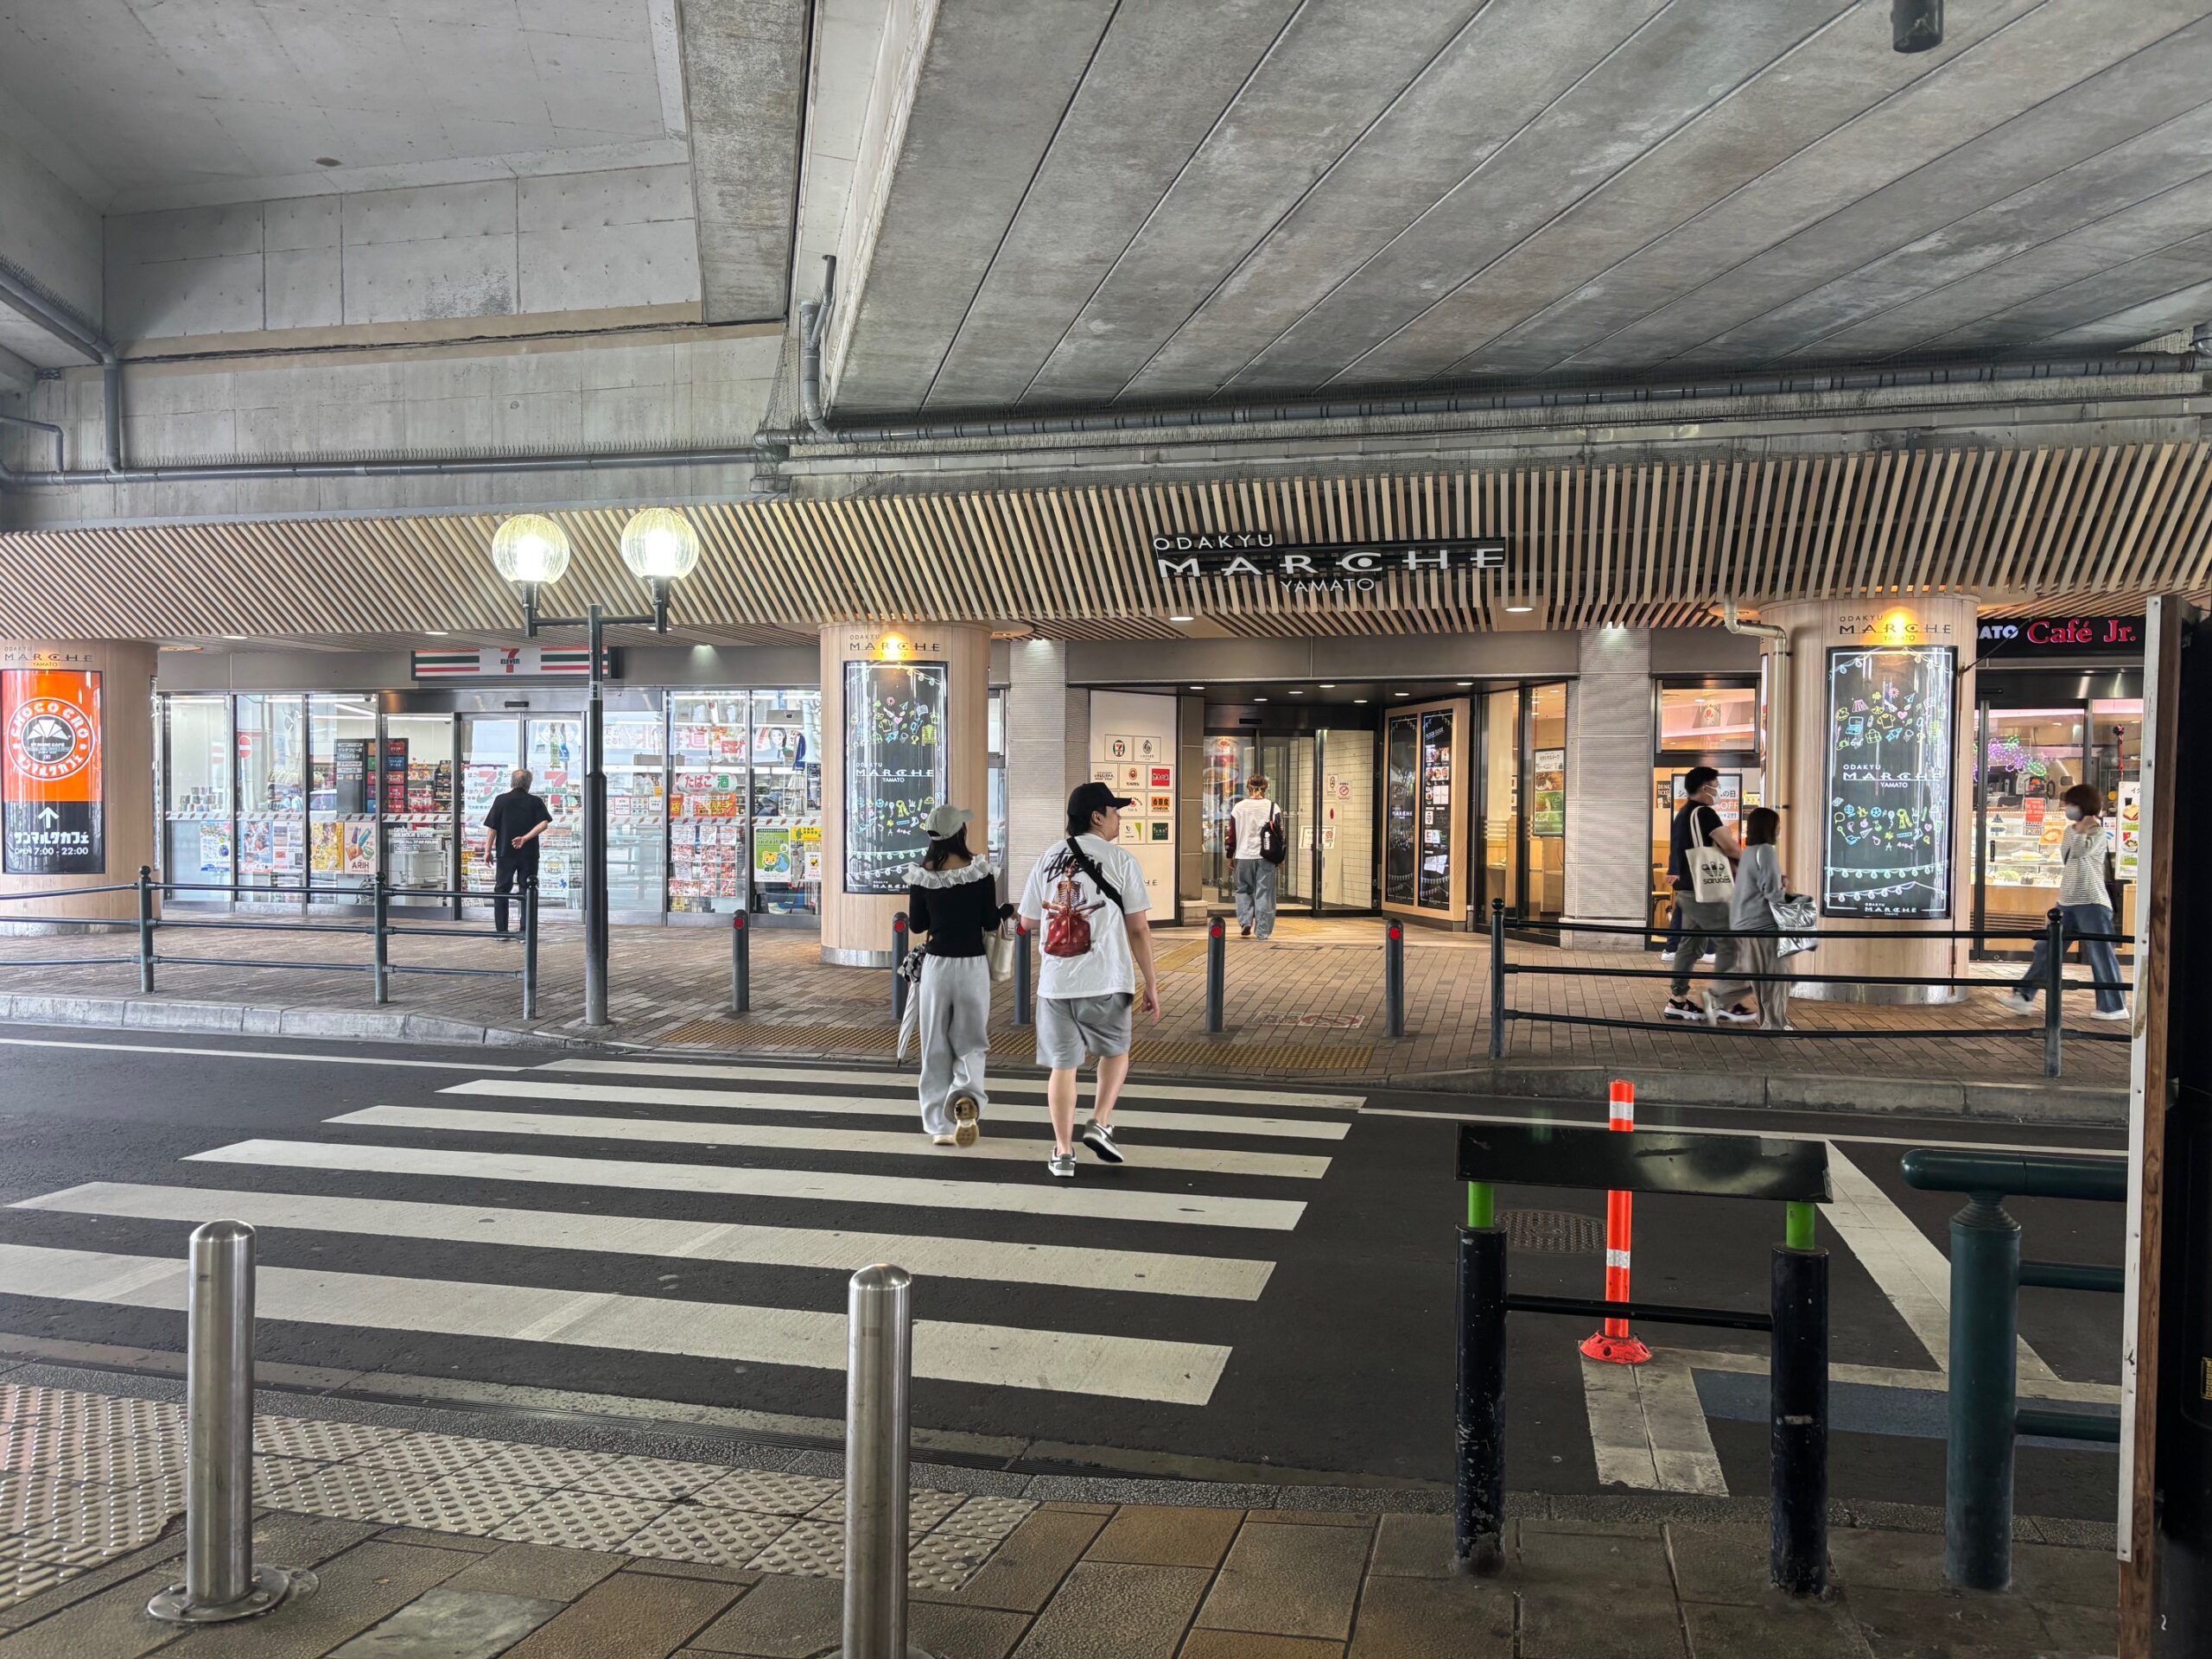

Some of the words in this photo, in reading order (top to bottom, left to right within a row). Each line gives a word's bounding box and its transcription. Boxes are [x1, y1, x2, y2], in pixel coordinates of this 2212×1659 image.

[1153, 534, 1274, 550] ODAKYU
[1157, 547, 1505, 578] MARCHE
[1280, 578, 1376, 594] YAMATO
[1840, 624, 1952, 634] MARCHE
[1977, 625, 2019, 639] ATO
[2027, 619, 2093, 644] Café
[2103, 620, 2137, 643] Jr.
[849, 642, 941, 652] MARCHE
[4, 653, 93, 662] MARCHE
[62, 708, 89, 739] CRO
[685, 775, 712, 788] たばこ
[717, 775, 729, 788] 酒
[1843, 772, 1942, 781] MARCHE
[14, 831, 89, 844] サンマルクカフェ
